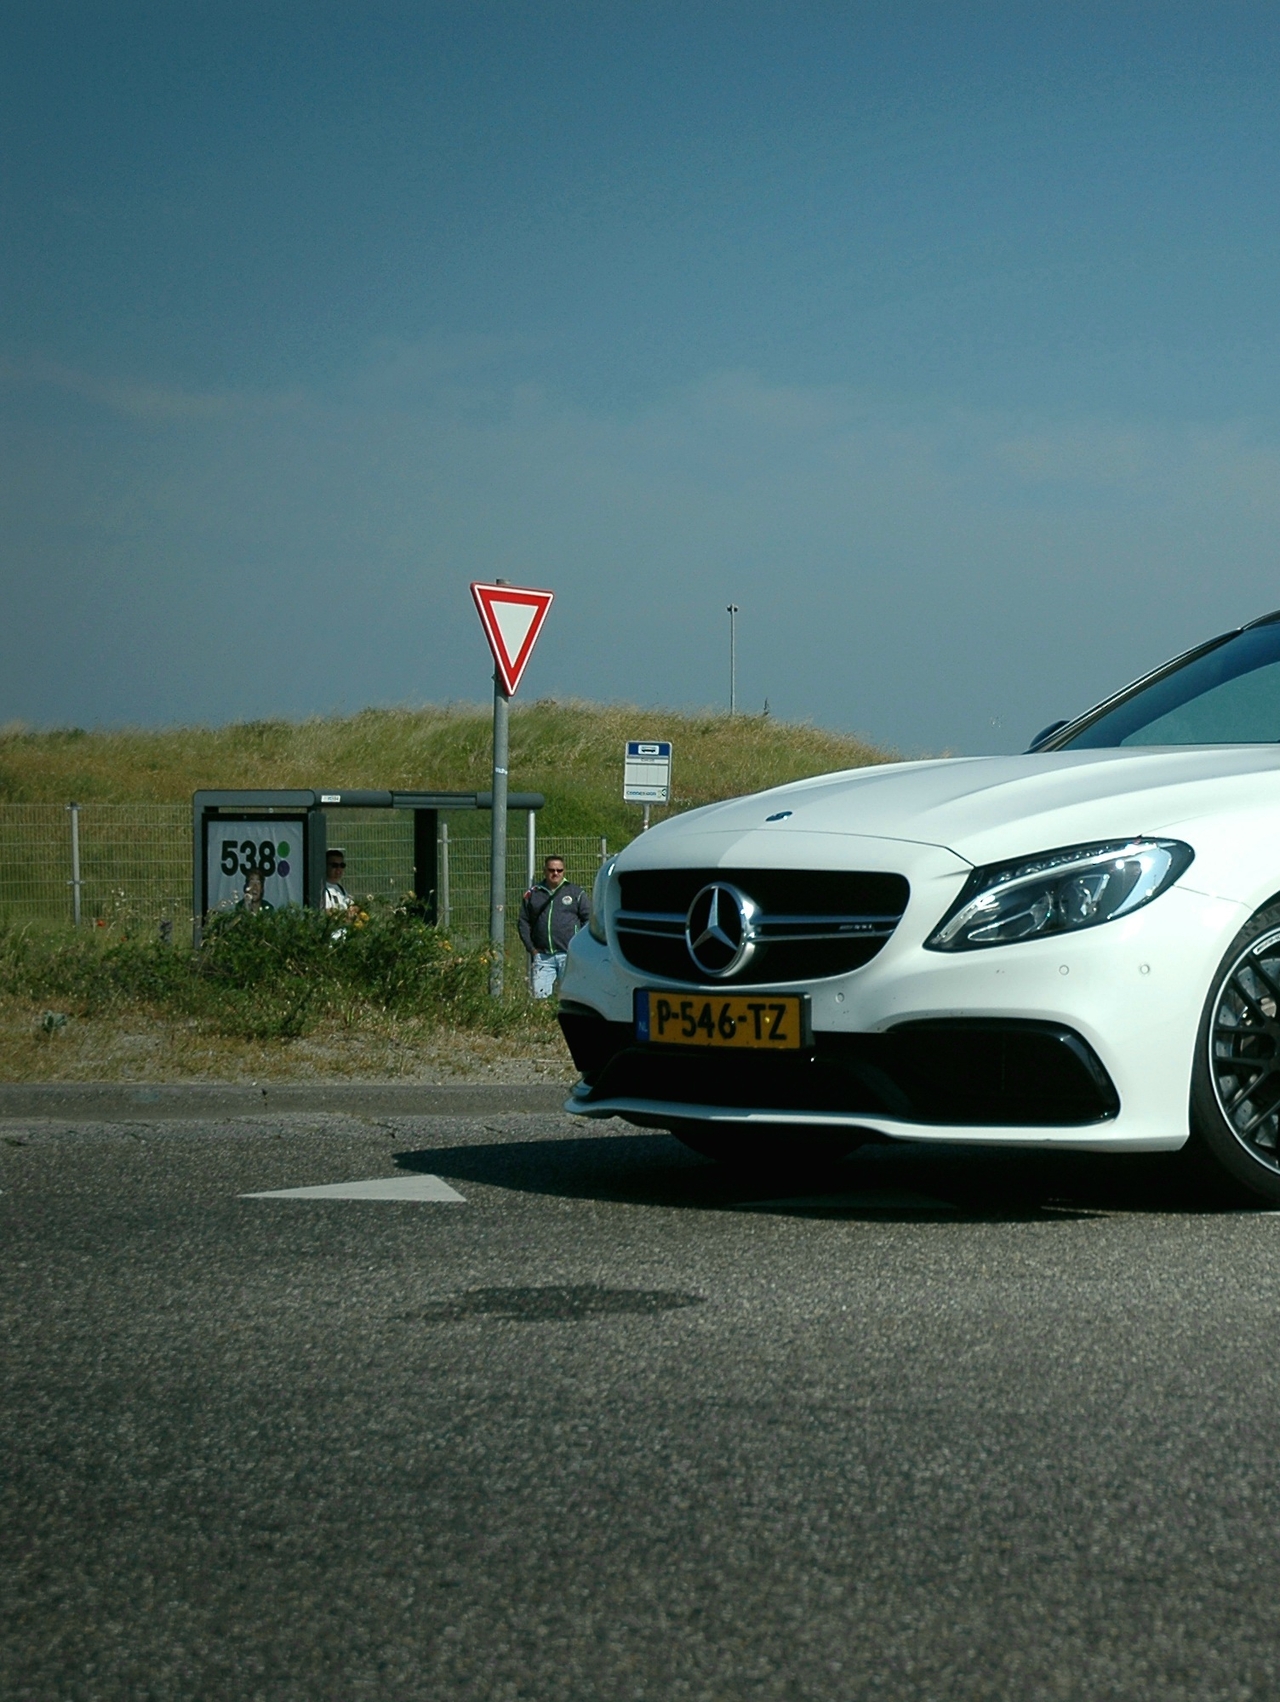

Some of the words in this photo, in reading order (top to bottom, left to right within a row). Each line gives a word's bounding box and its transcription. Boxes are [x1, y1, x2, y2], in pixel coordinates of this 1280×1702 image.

[221, 840, 276, 876] 538
[638, 1020, 648, 1033] NL
[656, 999, 788, 1041] P-546-TZ
